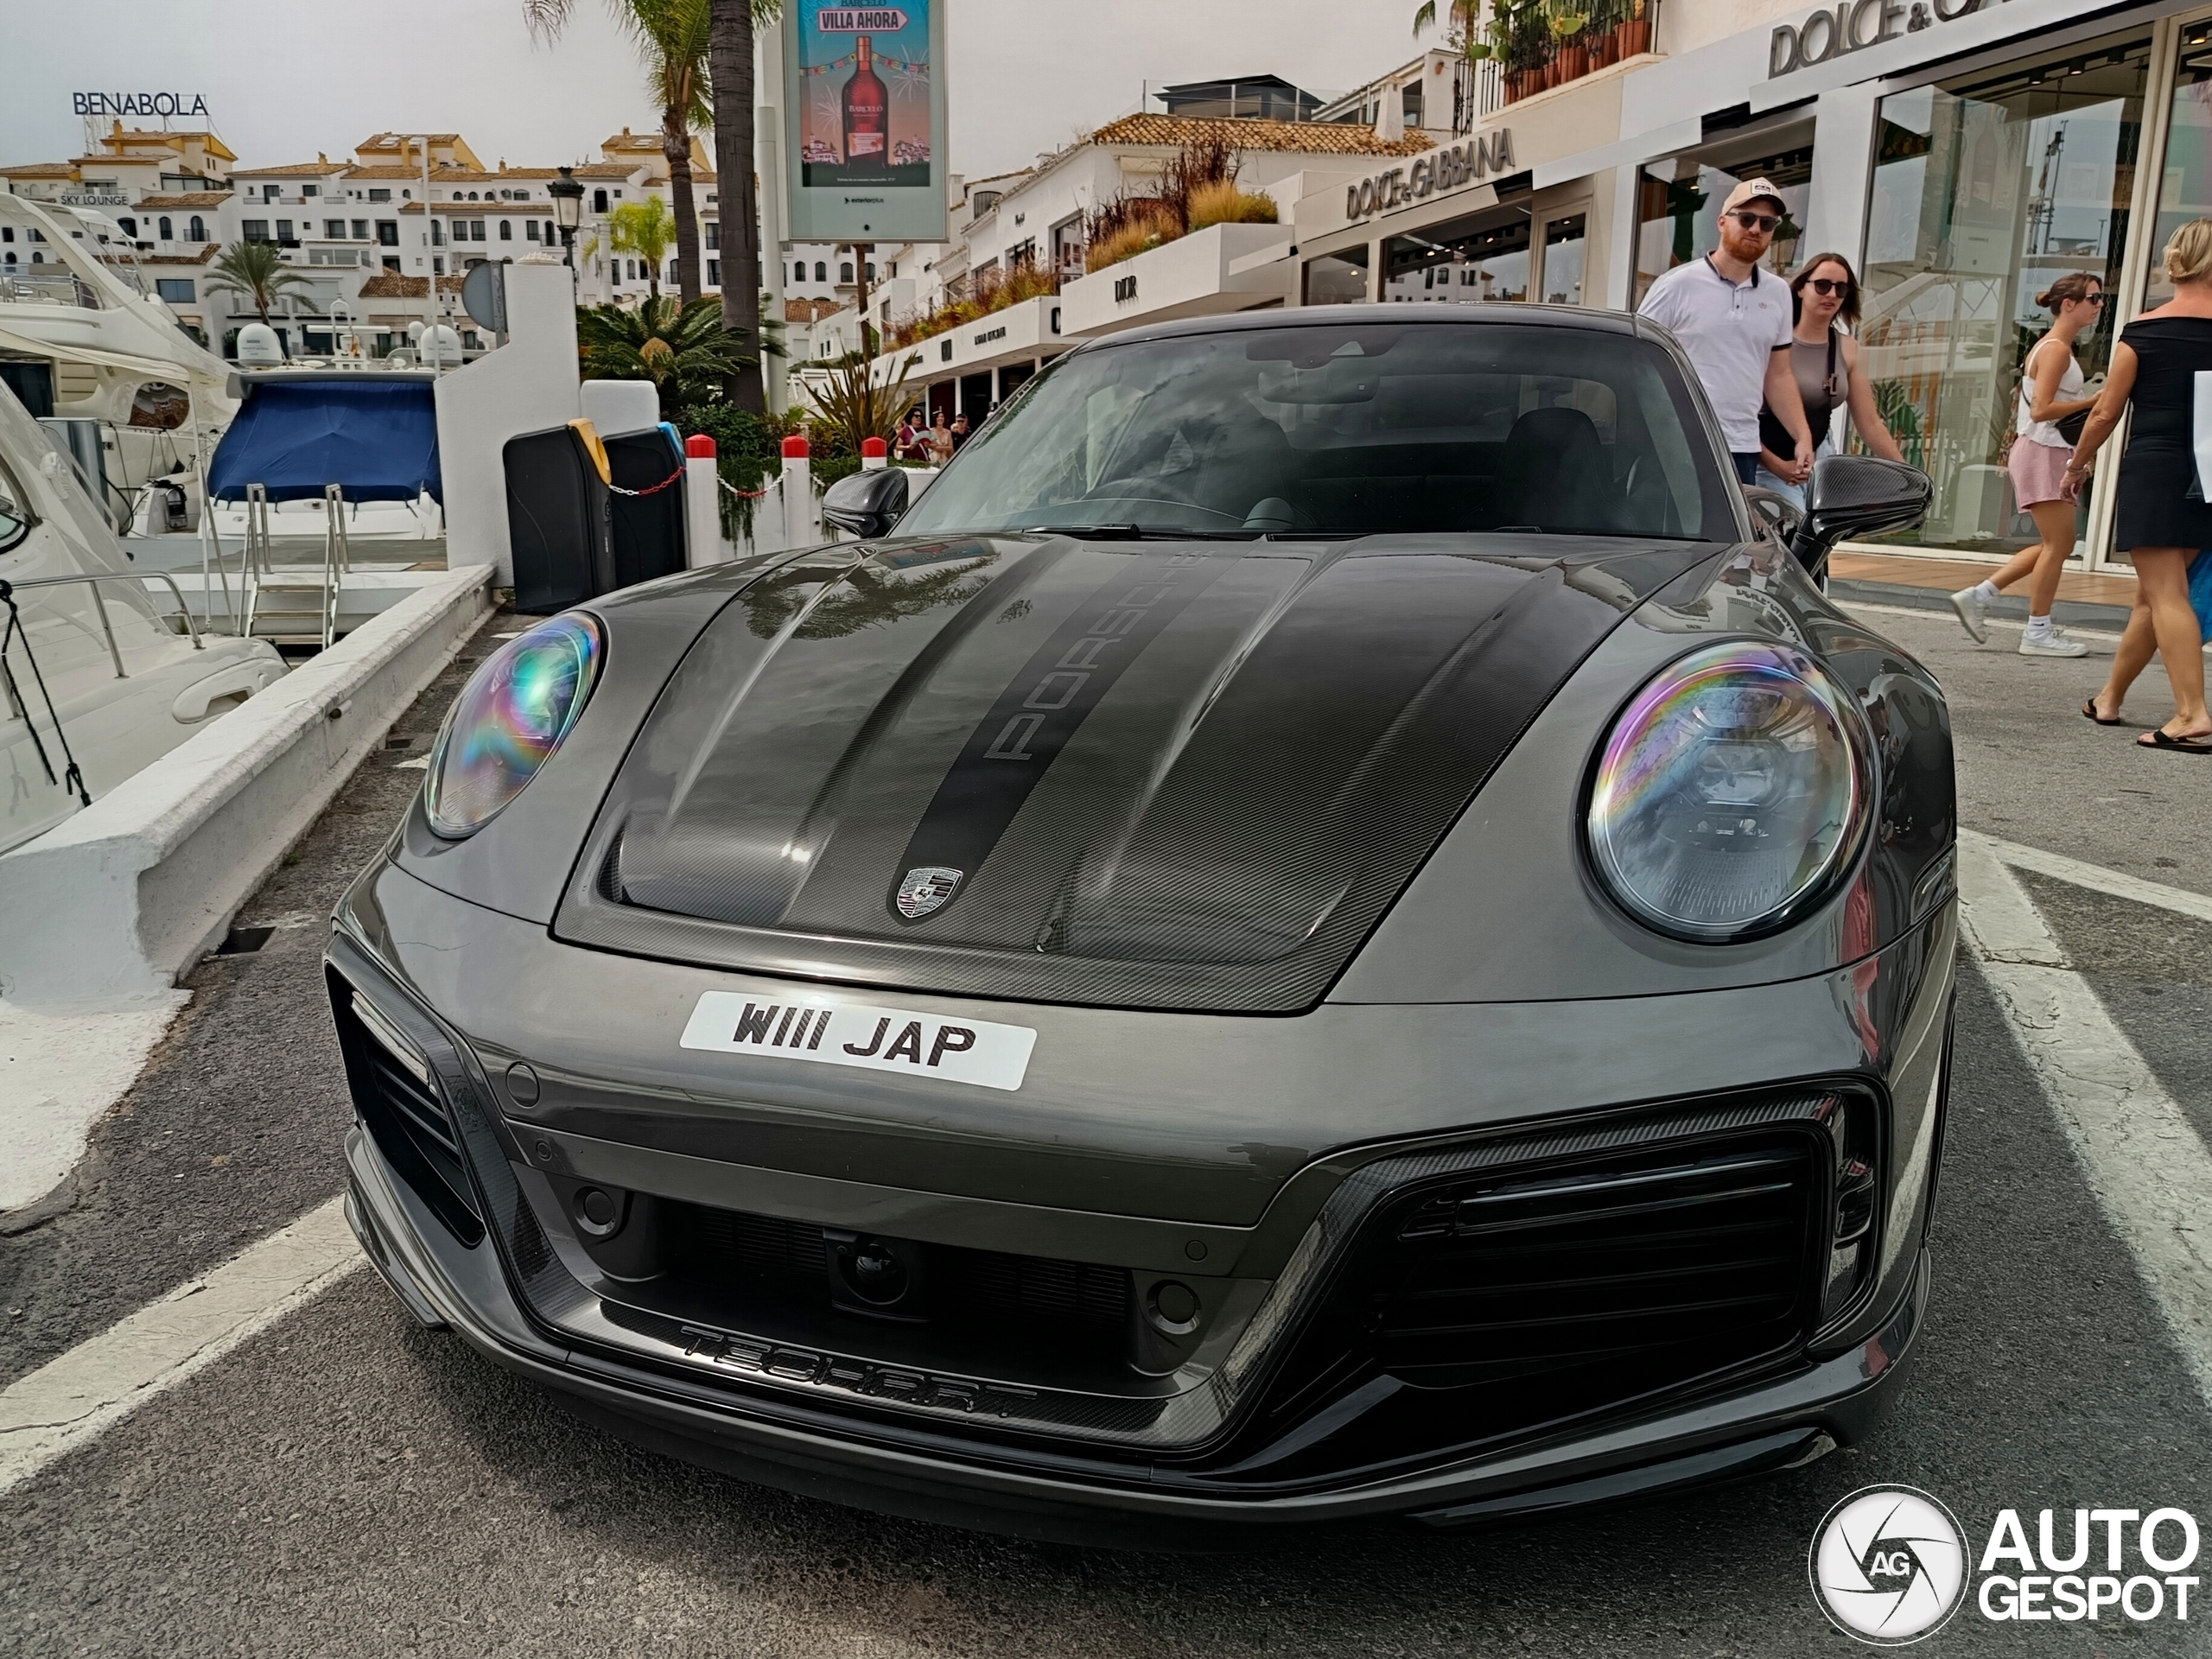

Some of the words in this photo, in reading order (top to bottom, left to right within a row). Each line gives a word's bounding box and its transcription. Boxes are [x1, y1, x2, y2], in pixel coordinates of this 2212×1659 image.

[822, 12, 854, 29] VILLA
[856, 11, 899, 29] AHORA
[73, 92, 209, 116] BENABOLA
[60, 195, 80, 205] SKY
[83, 195, 127, 206] LOUNGE
[1115, 275, 1138, 302] DIOR
[982, 550, 1217, 761] PORSCHE
[842, 1017, 976, 1066] JAP
[681, 1325, 1037, 1417] TECHART
